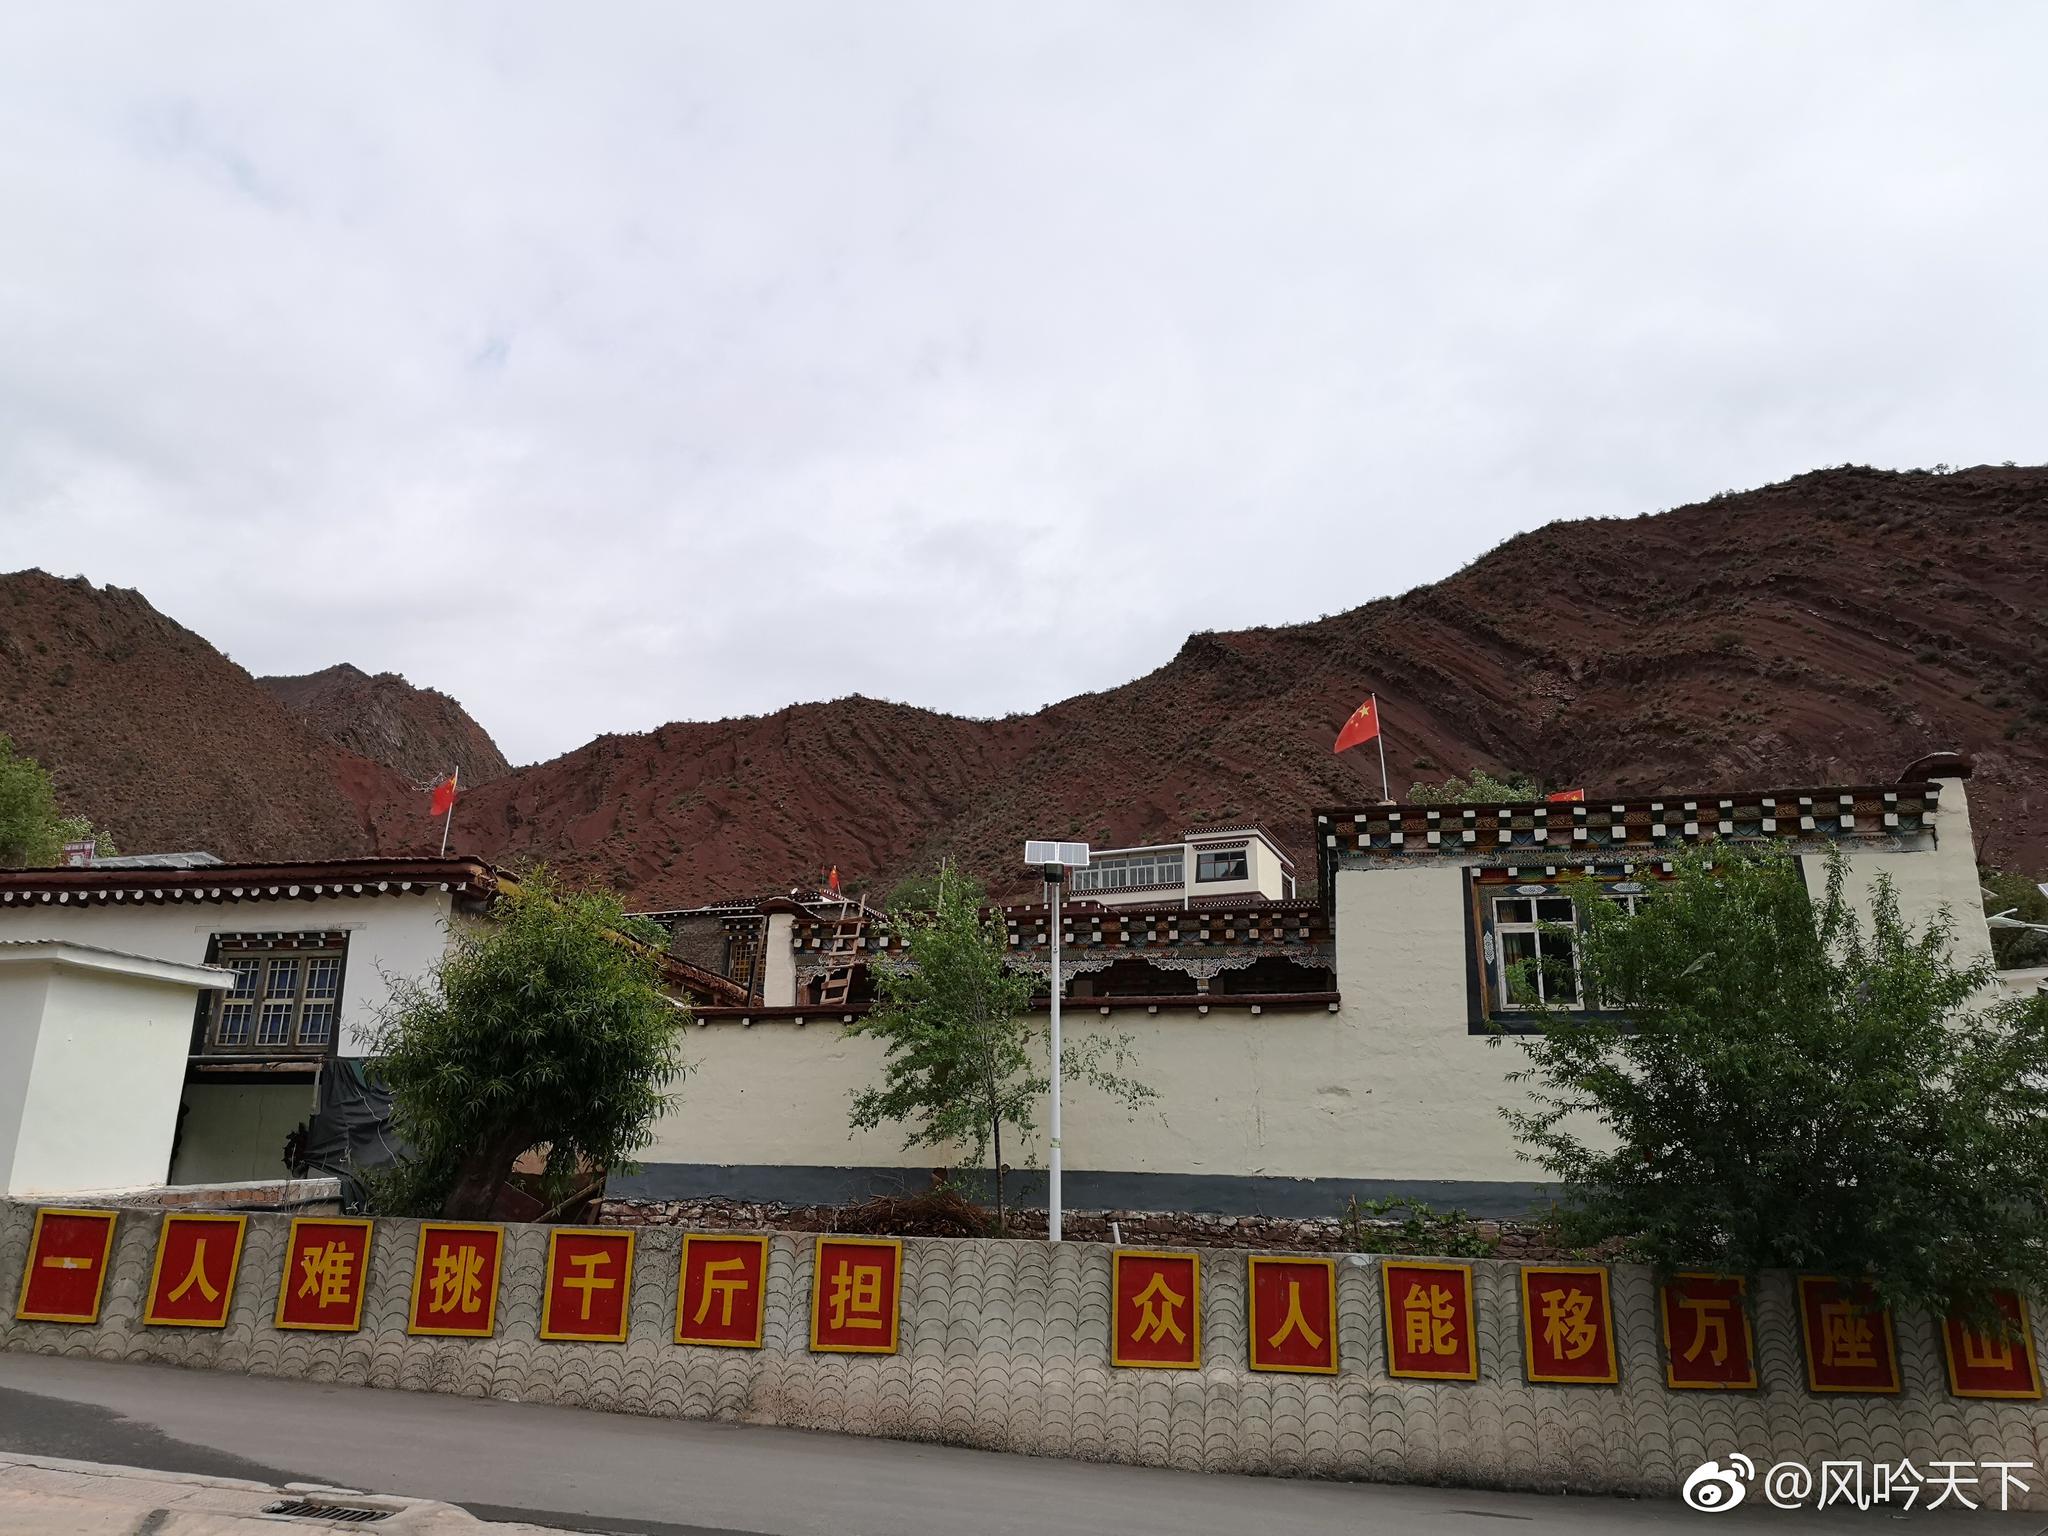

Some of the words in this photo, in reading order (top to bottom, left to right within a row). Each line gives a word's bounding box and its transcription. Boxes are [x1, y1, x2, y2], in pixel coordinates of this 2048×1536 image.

[42, 1238, 882, 1330] 一人难挑千斤担
[1132, 1272, 2013, 1371] 众人能移万座山
